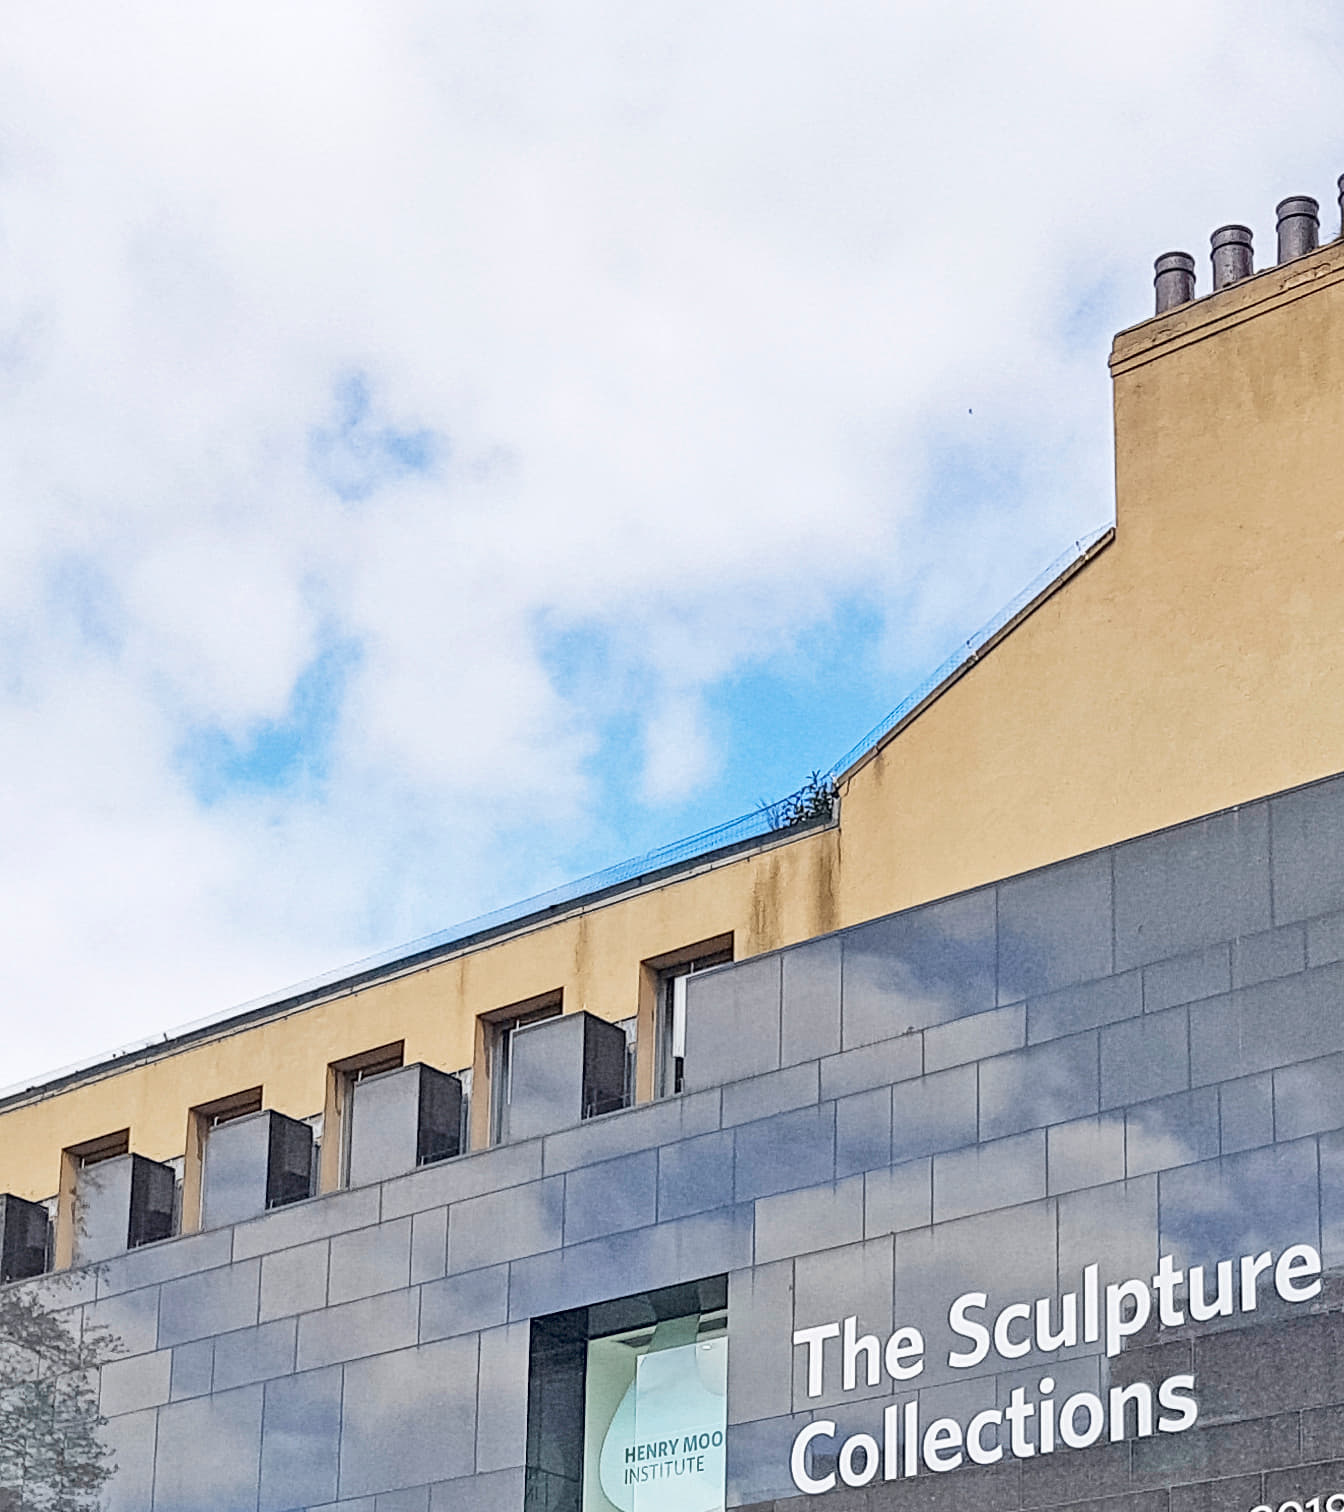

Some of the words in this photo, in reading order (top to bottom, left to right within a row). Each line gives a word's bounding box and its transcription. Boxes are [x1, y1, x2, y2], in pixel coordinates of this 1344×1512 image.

[793, 1315, 924, 1398] The
[948, 1242, 1322, 1368] Sculpture
[624, 1455, 705, 1484] INSTITUTE
[625, 1438, 679, 1463] HENRY
[791, 1372, 1198, 1494] Collections
